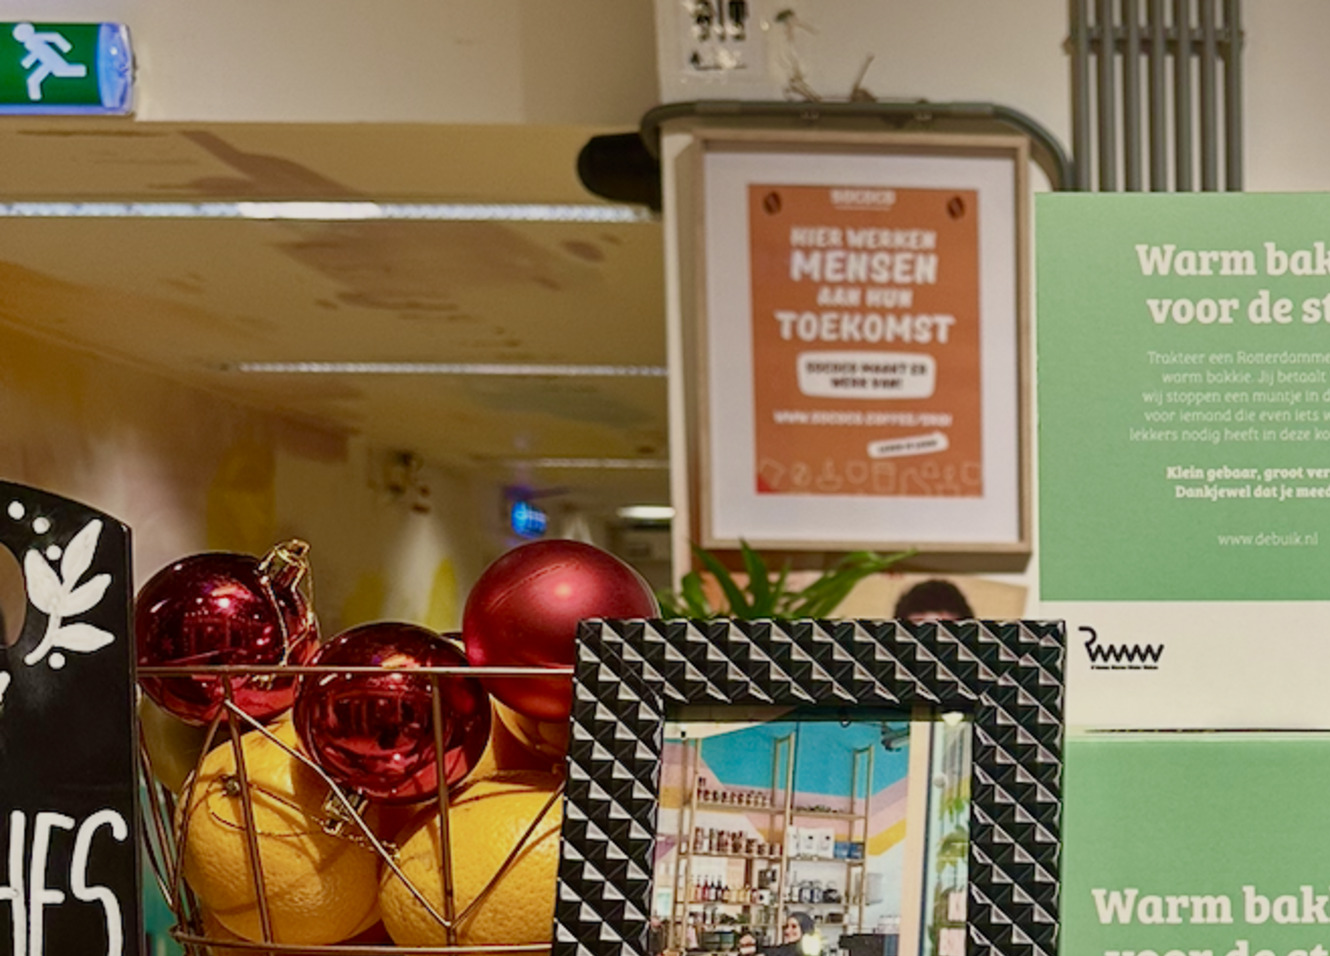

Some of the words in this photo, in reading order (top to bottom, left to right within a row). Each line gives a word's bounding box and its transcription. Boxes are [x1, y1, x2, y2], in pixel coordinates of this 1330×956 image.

[790, 228, 843, 247] HIER
[846, 229, 937, 249] WERKEN
[789, 250, 938, 284] MENSEN
[1136, 244, 1256, 276] Warm
[817, 287, 862, 306] AAN
[865, 289, 914, 308] HUN
[1147, 298, 1240, 325] voor
[1247, 290, 1292, 324] de
[775, 311, 955, 344] TOEKOMST
[1147, 350, 1205, 365] Trakteer
[1208, 352, 1234, 365] een
[1163, 372, 1202, 384] warm
[1206, 370, 1252, 384] bakkie.
[1258, 370, 1274, 387] Jij
[1277, 370, 1326, 384] betaalt
[1142, 390, 1163, 406] wij
[1166, 390, 1221, 406] stoppen
[1224, 392, 1249, 404] een
[1252, 390, 1302, 406] muntje
[1305, 390, 1319, 404] in
[1144, 411, 1176, 424] voor
[1180, 409, 1232, 424] iemand
[1235, 409, 1256, 424] die
[1259, 411, 1291, 424] even
[1295, 410, 1319, 423] iets
[1130, 428, 1179, 443] lekkers
[1181, 428, 1220, 446] nodig
[1223, 427, 1260, 443] heeft
[1263, 428, 1277, 442] in
[1280, 428, 1311, 442] deze
[1166, 465, 1204, 480] Klein
[1206, 465, 1261, 483] gebaar,
[1264, 466, 1304, 483] groot
[1175, 484, 1251, 501] Dankjewel
[1253, 484, 1278, 499] dat
[1279, 484, 1294, 501] je
[1217, 531, 1319, 547] www.debuik.nl
[1091, 887, 1234, 925] Warm
